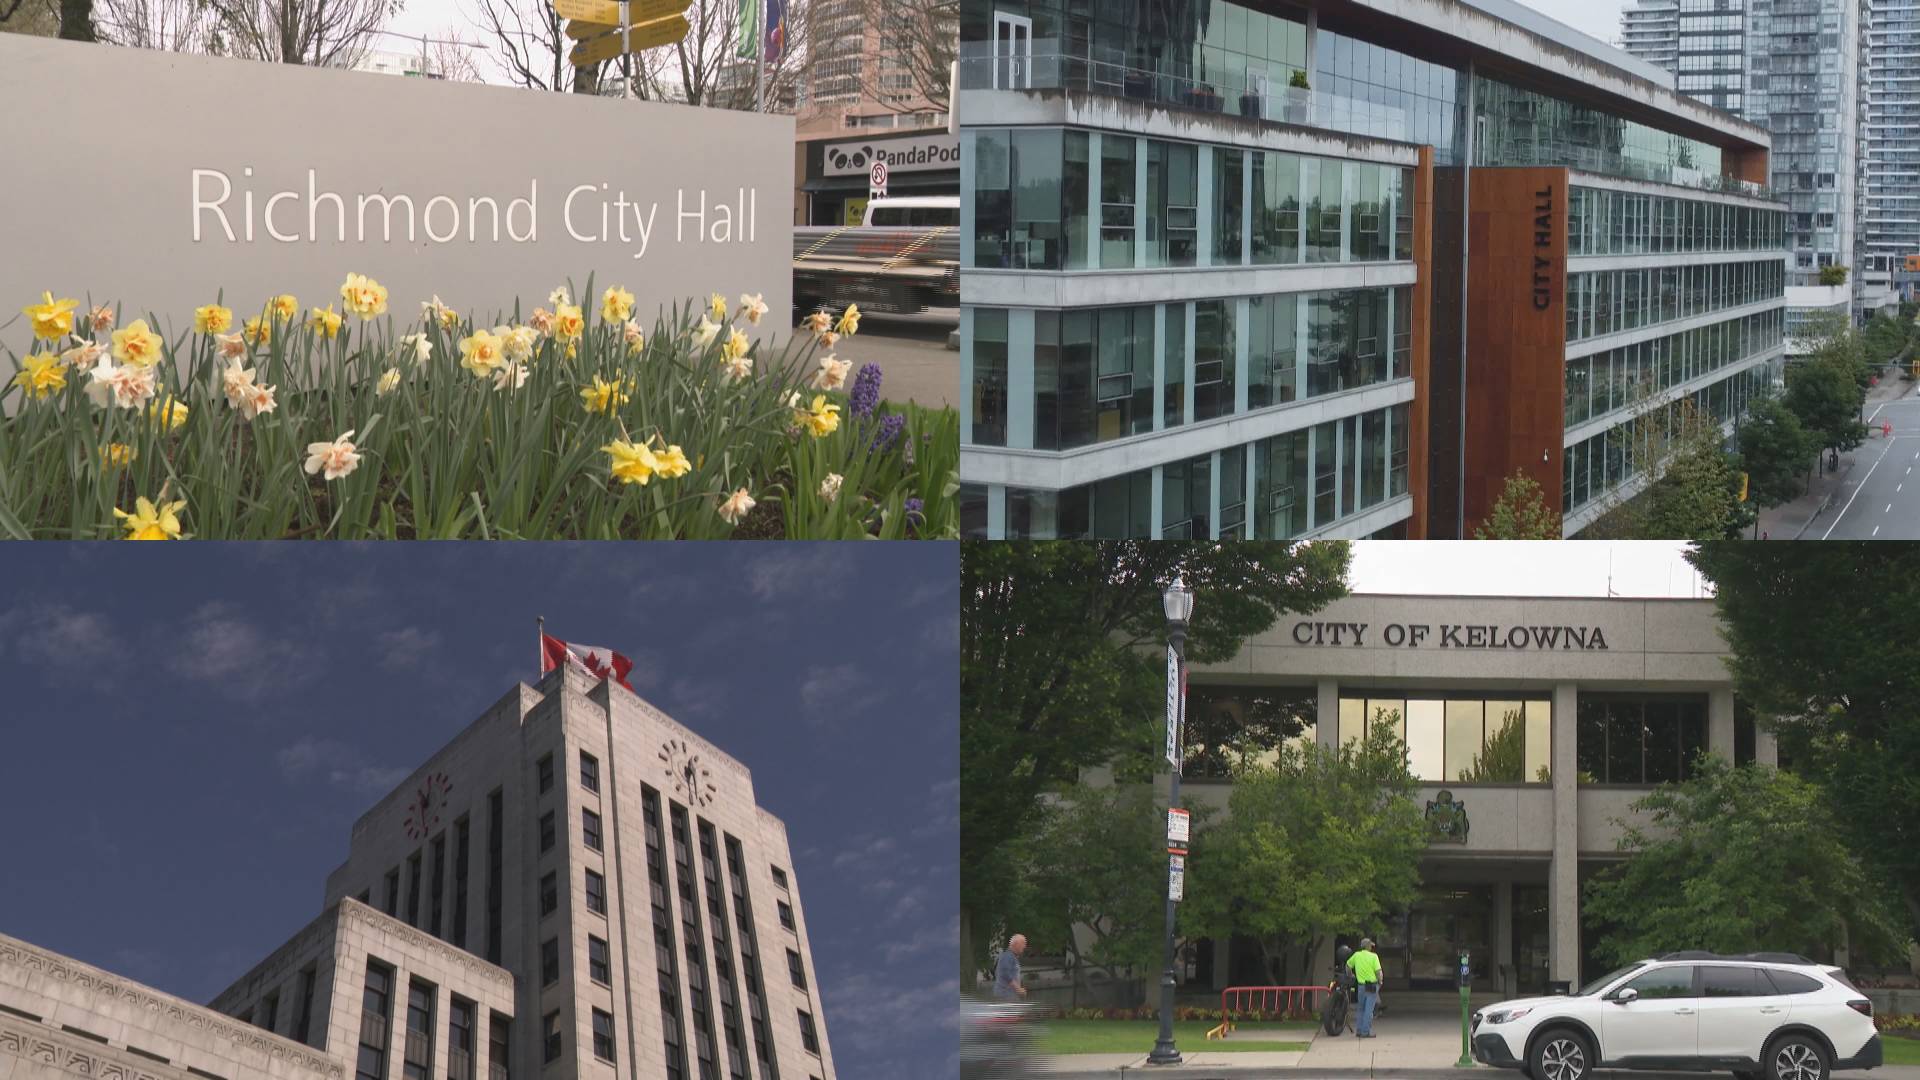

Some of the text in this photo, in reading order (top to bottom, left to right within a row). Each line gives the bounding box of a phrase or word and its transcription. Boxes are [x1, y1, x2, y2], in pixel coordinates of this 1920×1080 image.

[876, 142, 960, 166] PandaPod
[191, 167, 756, 259] Richmond City Hall
[1532, 185, 1552, 311] CITY HALL
[1293, 622, 1609, 650] CITY OF KELOWNA
